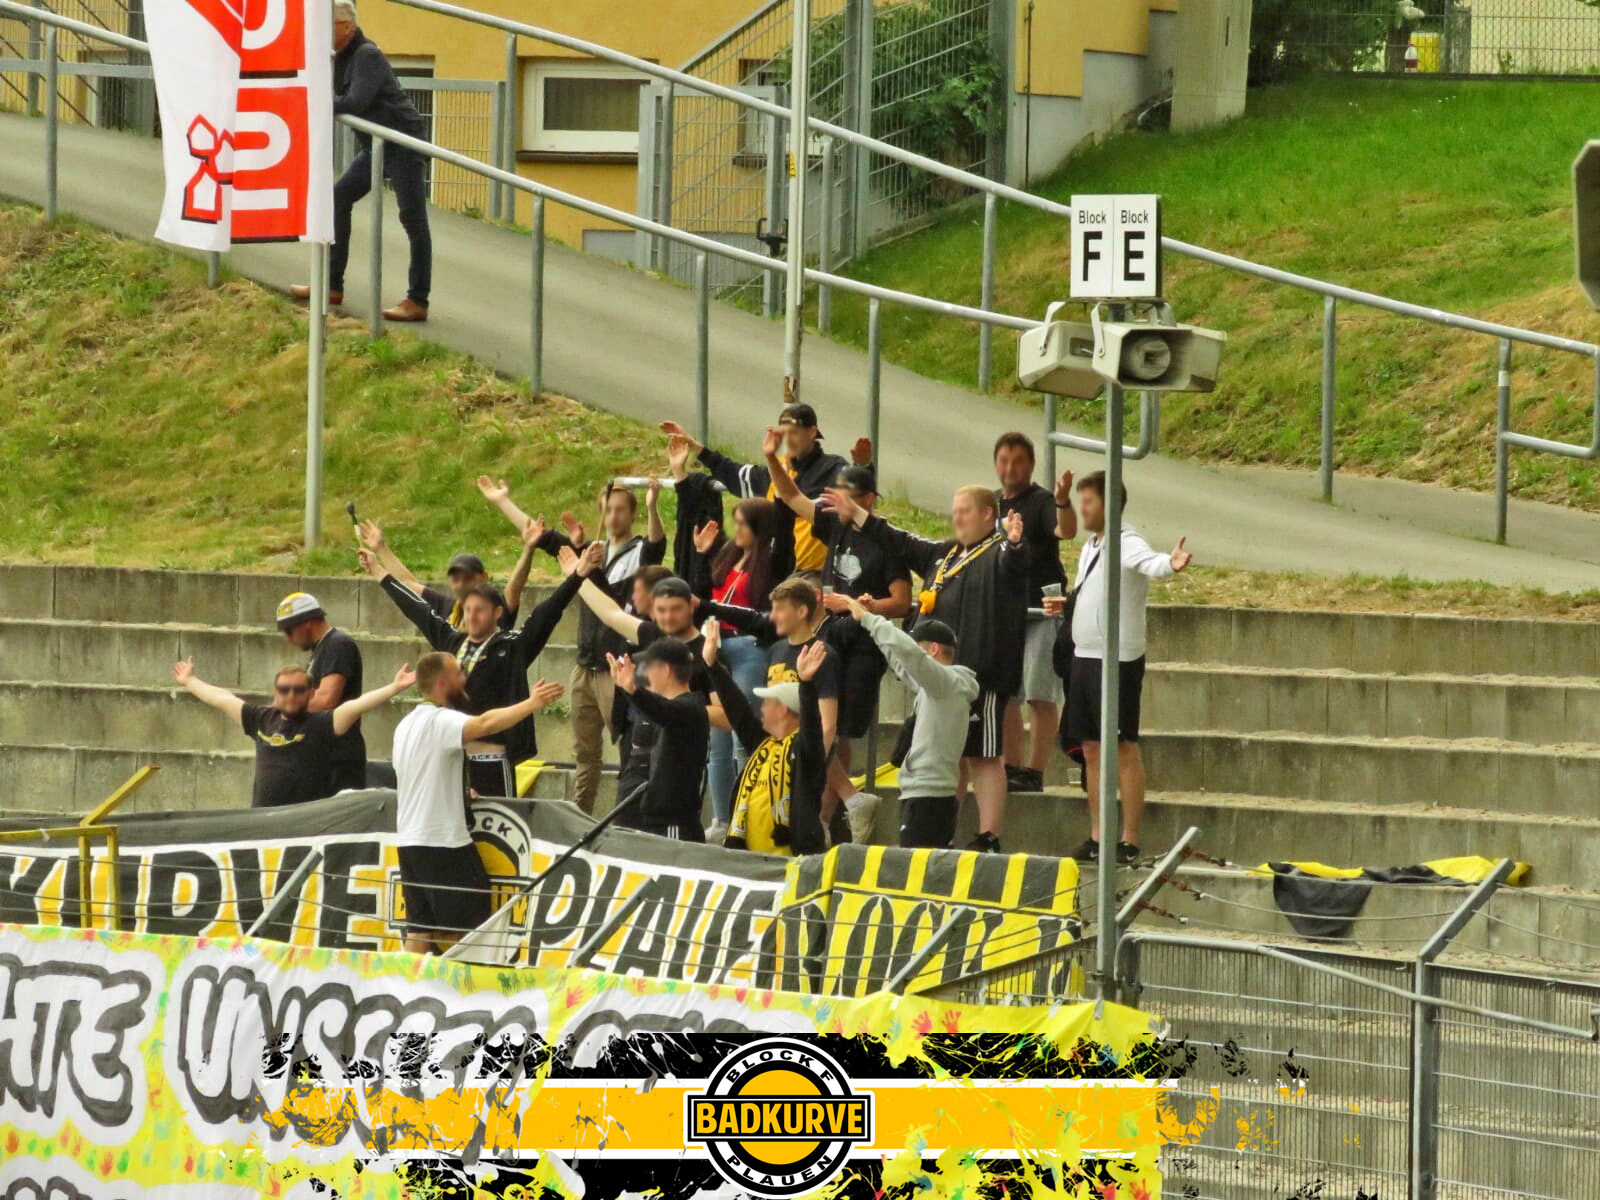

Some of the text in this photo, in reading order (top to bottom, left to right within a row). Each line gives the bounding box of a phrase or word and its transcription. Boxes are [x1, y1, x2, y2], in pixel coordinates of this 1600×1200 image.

[1079, 210, 1106, 224] Block
[1121, 209, 1149, 224] Block
[1082, 231, 1103, 282] F
[1123, 231, 1145, 282] E
